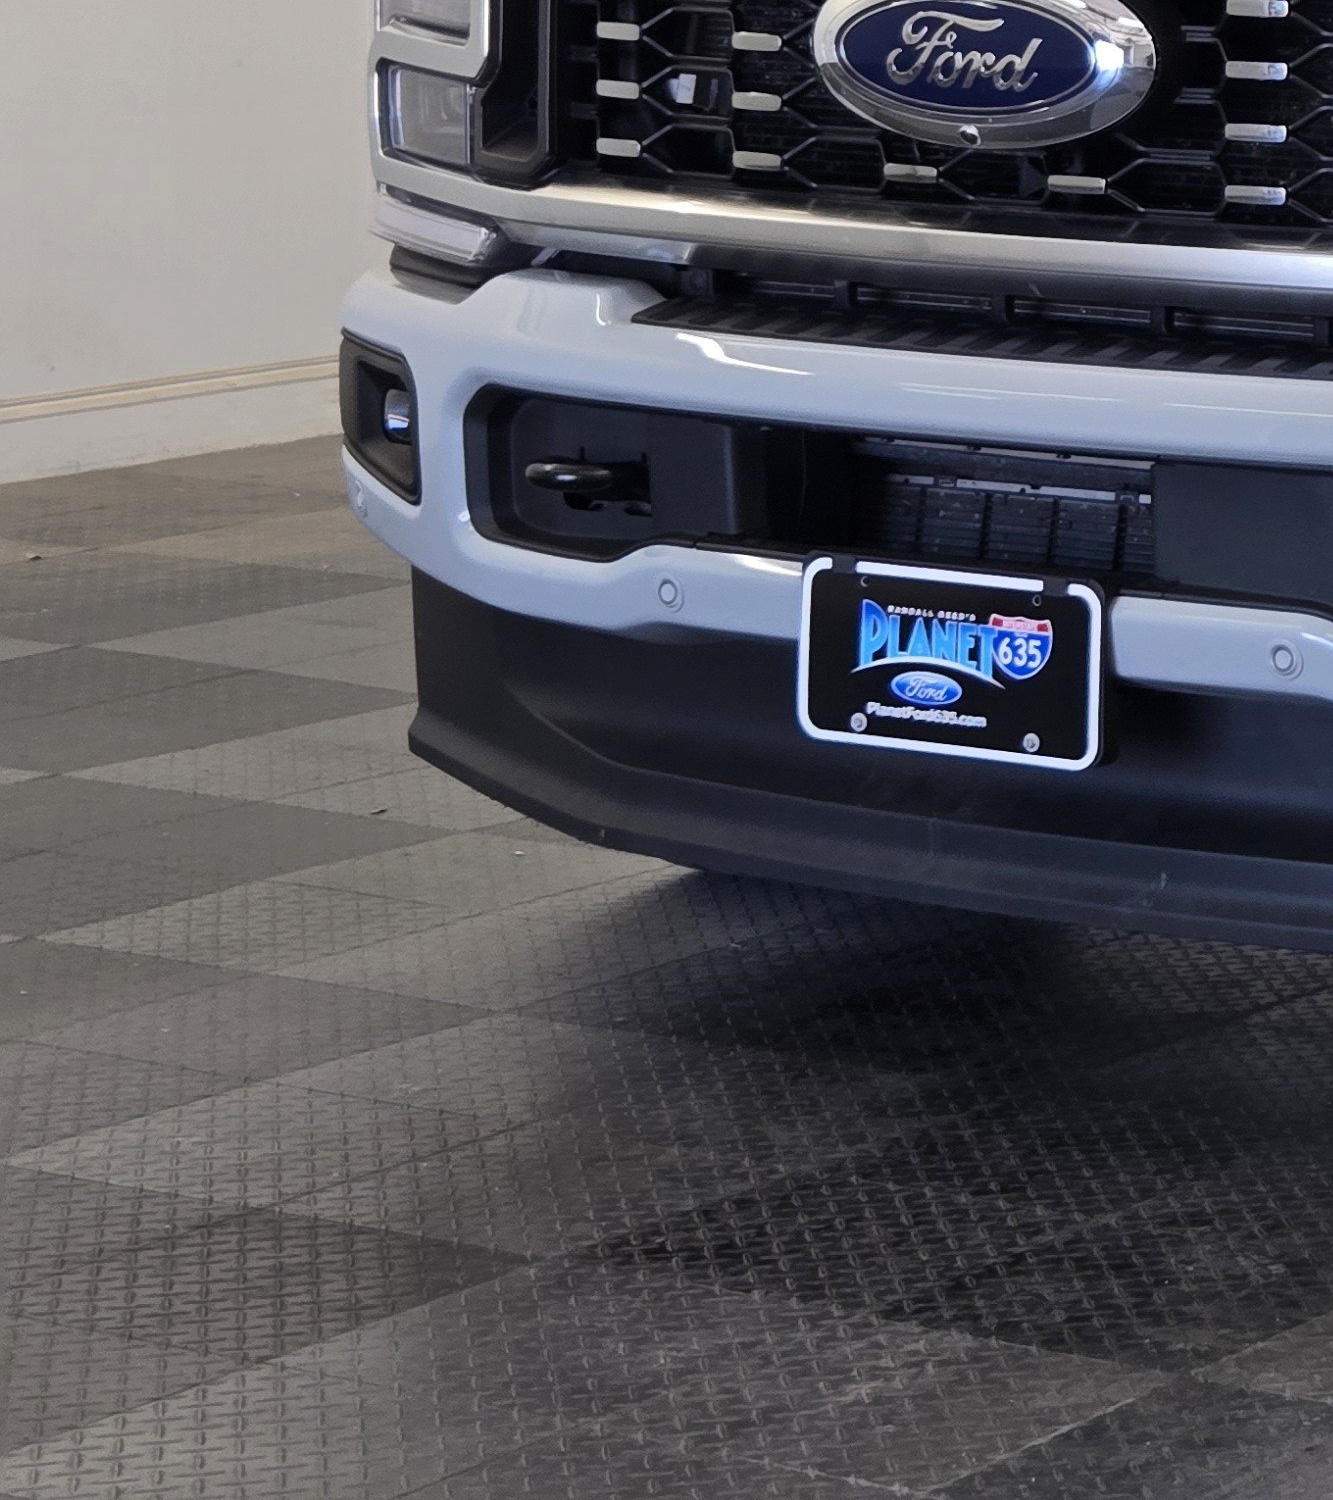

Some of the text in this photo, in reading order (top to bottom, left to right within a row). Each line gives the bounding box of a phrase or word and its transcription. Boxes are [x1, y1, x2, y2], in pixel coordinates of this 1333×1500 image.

[886, 10, 1044, 92] Ford
[860, 598, 1042, 679] PLANET 635
[904, 677, 949, 701] Ford
